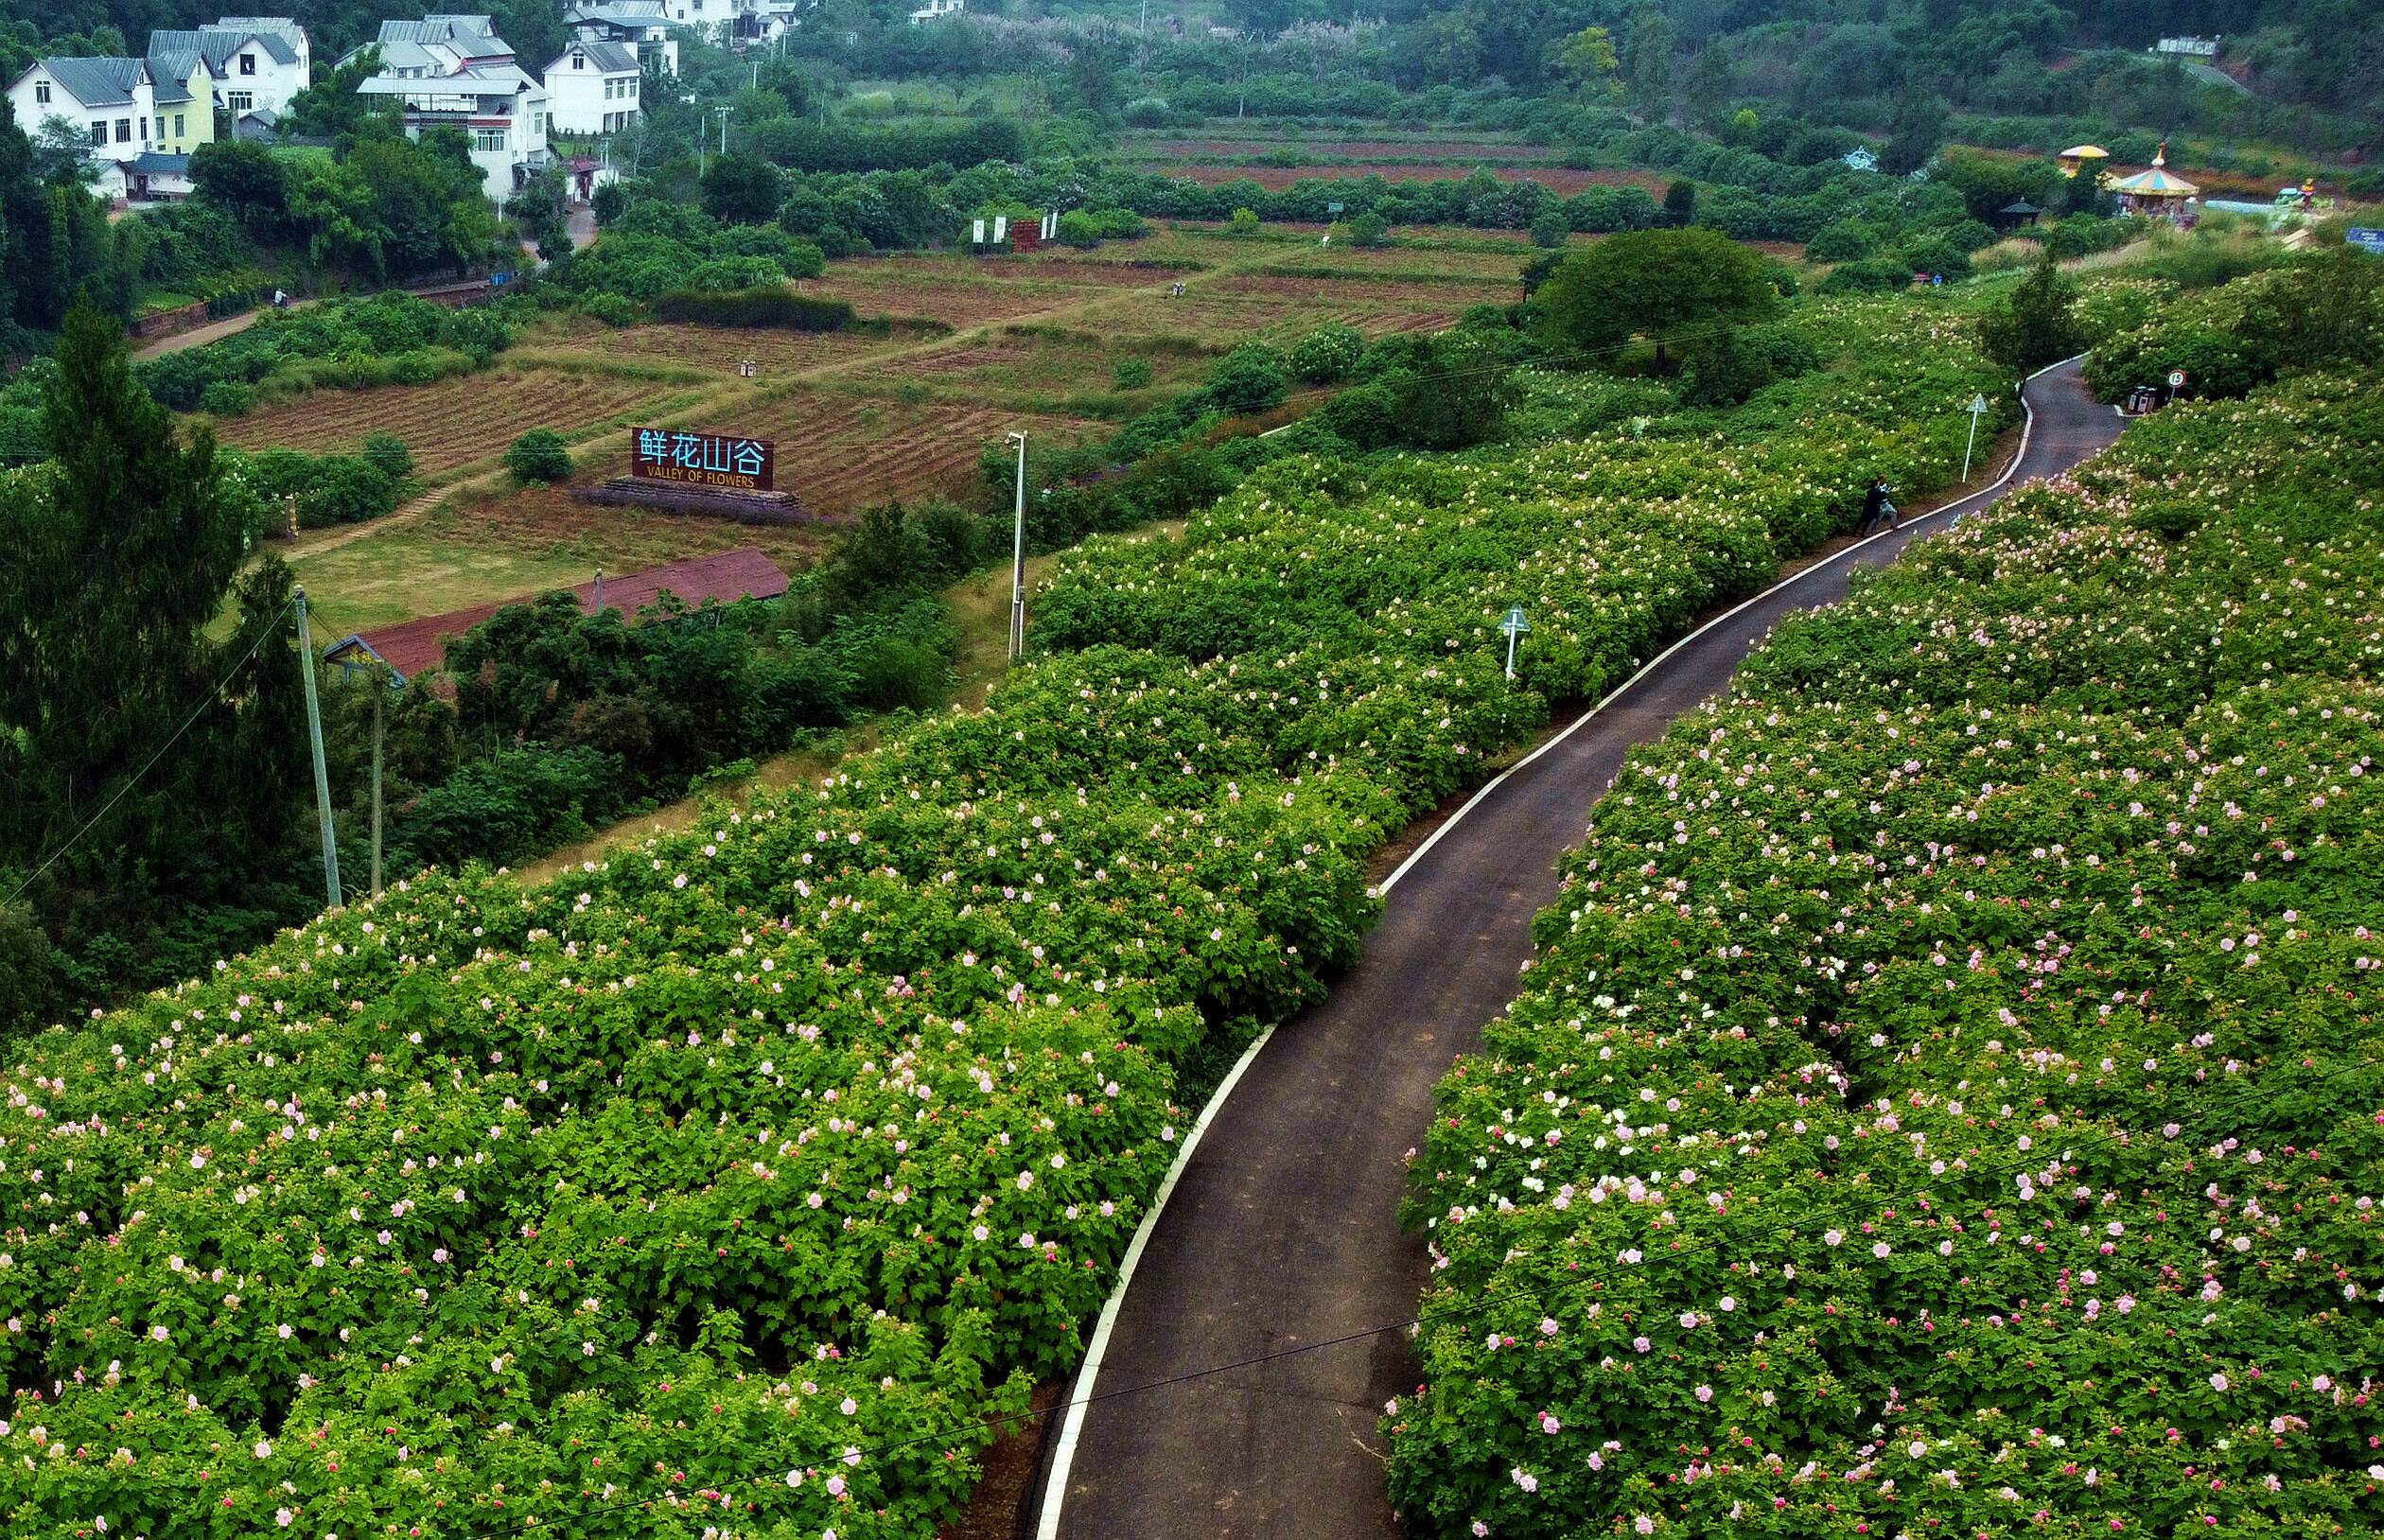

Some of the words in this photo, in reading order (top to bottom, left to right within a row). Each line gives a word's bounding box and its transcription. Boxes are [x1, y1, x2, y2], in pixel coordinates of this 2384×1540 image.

[640, 429, 764, 475] 鲜花山谷
[647, 465, 683, 480] VALLEY
[688, 469, 703, 482] OF
[707, 472, 755, 488] FLOWERS
